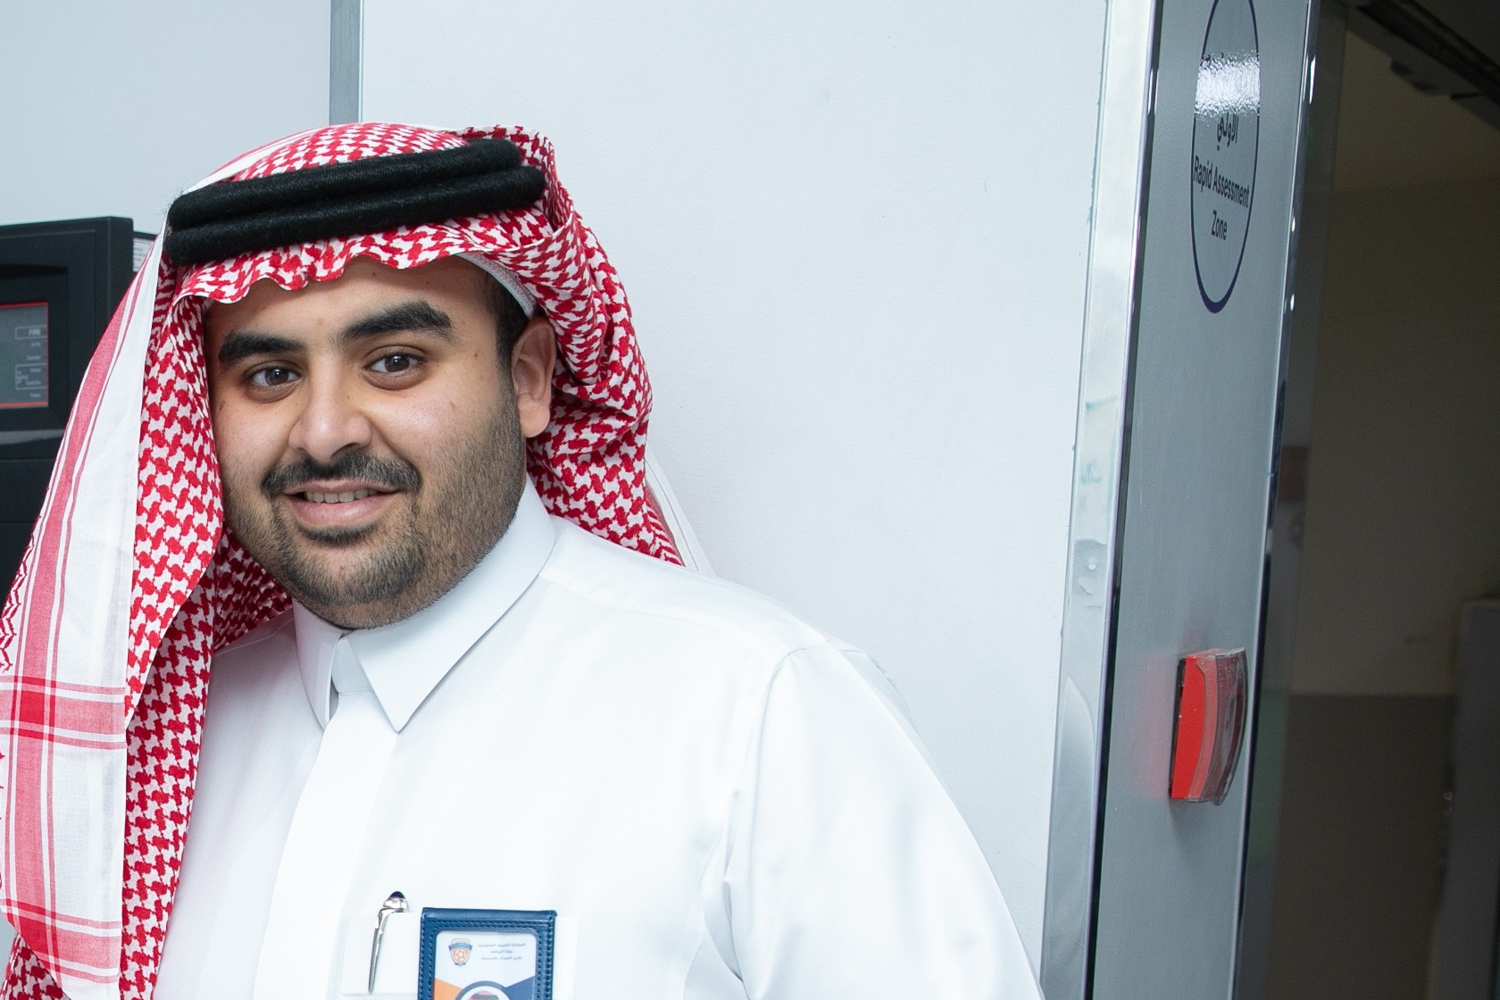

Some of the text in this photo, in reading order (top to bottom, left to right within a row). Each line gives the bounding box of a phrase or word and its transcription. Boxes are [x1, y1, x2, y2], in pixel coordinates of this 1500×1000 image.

[1193, 155, 1250, 208] Rapid Assessment
[1211, 209, 1228, 241] Zone
